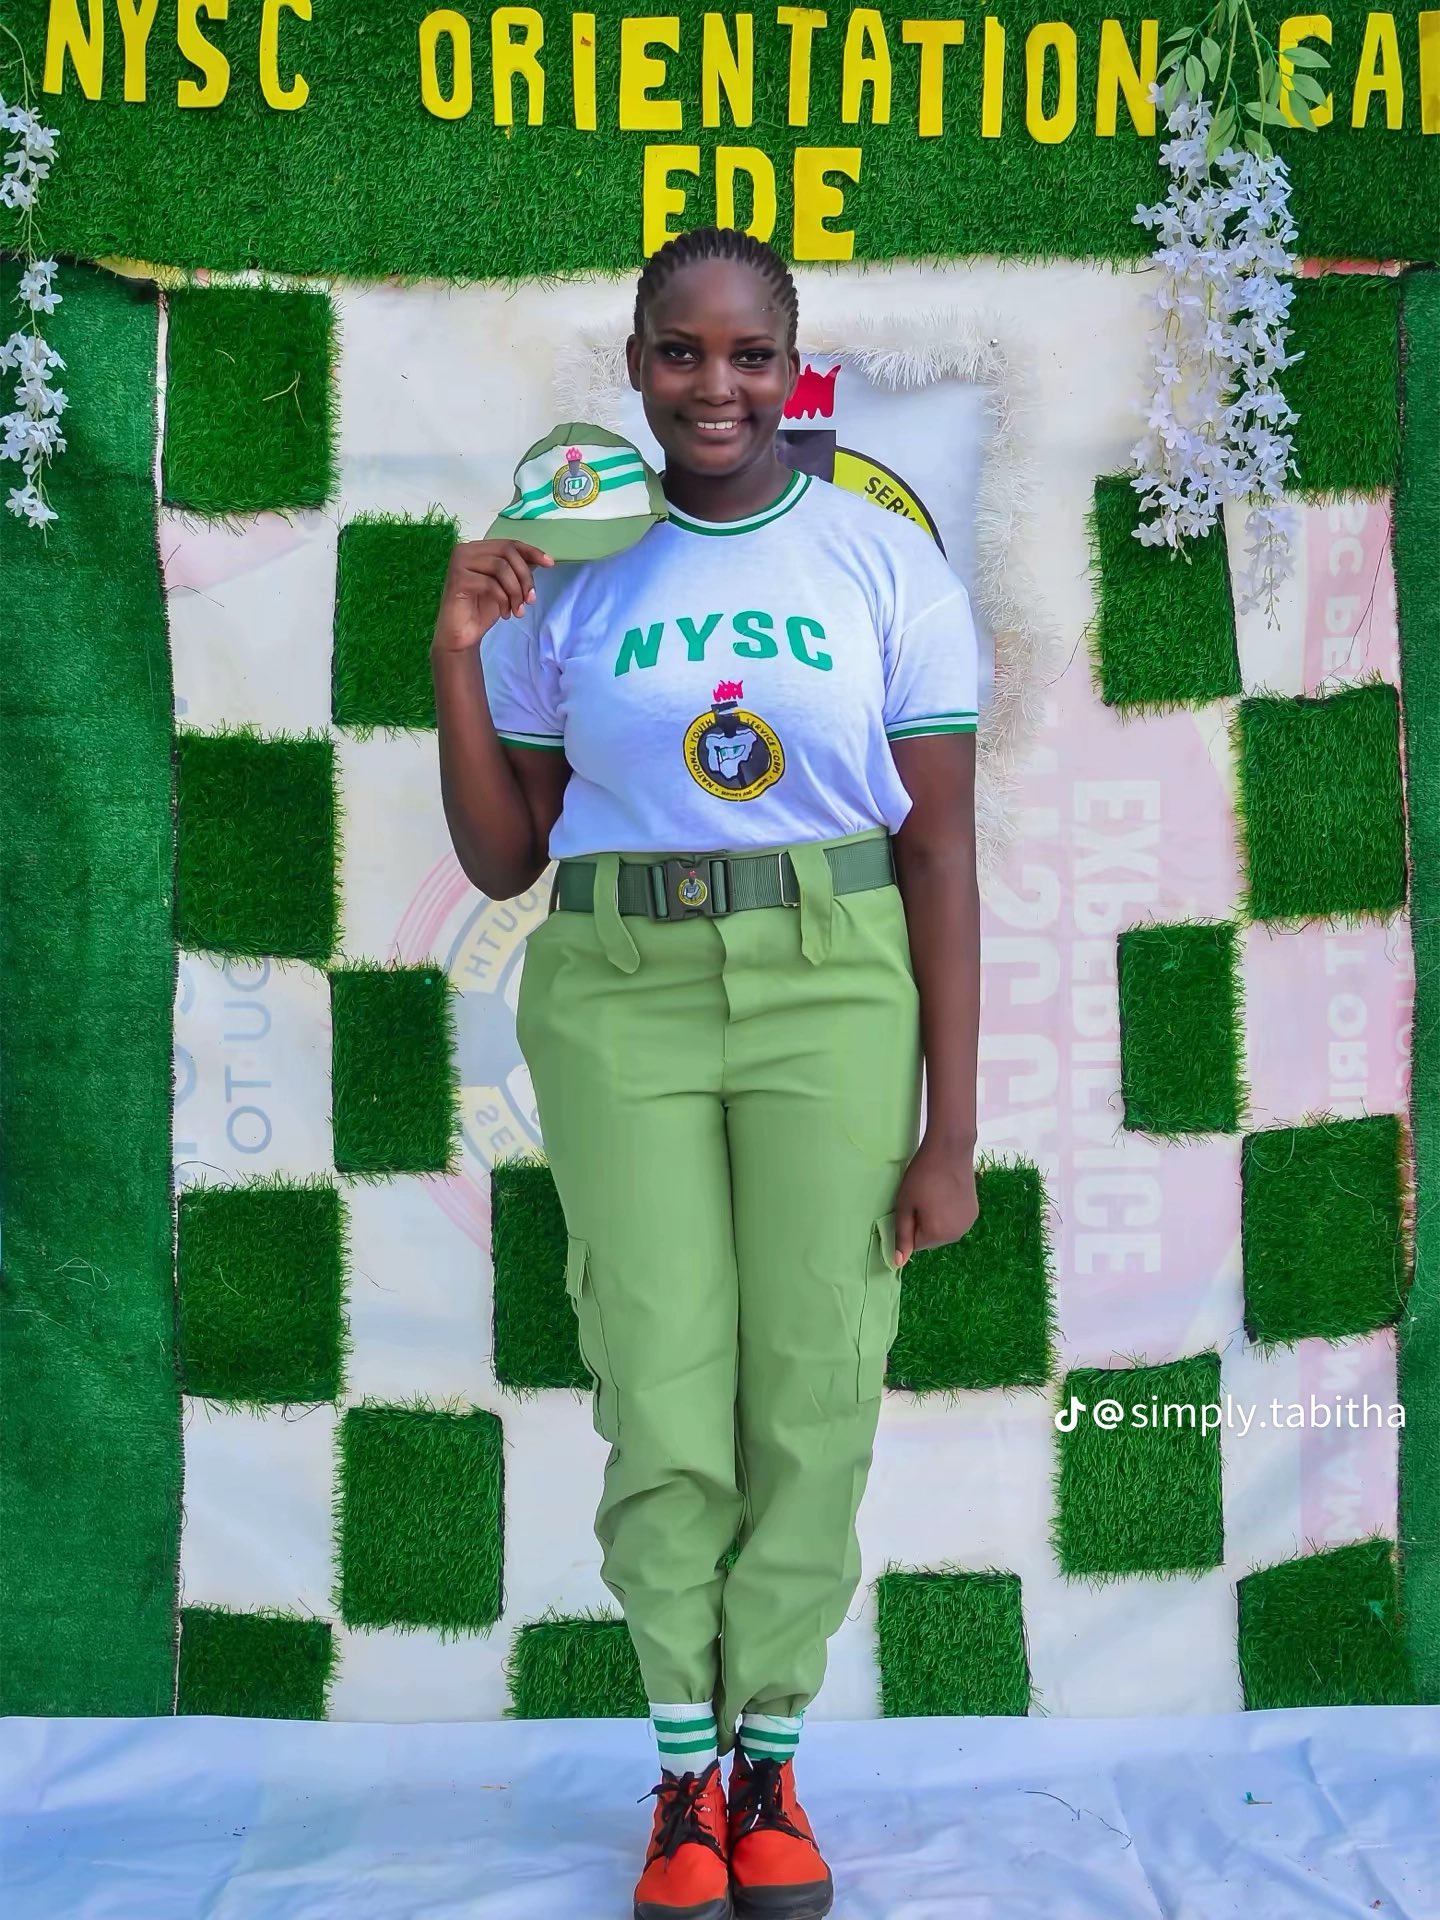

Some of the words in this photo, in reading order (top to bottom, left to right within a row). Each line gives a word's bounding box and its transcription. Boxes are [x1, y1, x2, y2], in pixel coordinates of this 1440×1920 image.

[43, 0, 312, 110] NYSC
[419, 6, 1158, 144] ORIENTATION
[1279, 11, 1440, 135] CA
[643, 145, 862, 260] EDE
[614, 610, 833, 677] NYSC
[690, 718, 713, 743] YOUTH
[746, 718, 777, 747] SERVICE
[689, 747, 714, 789] NATIONAL
